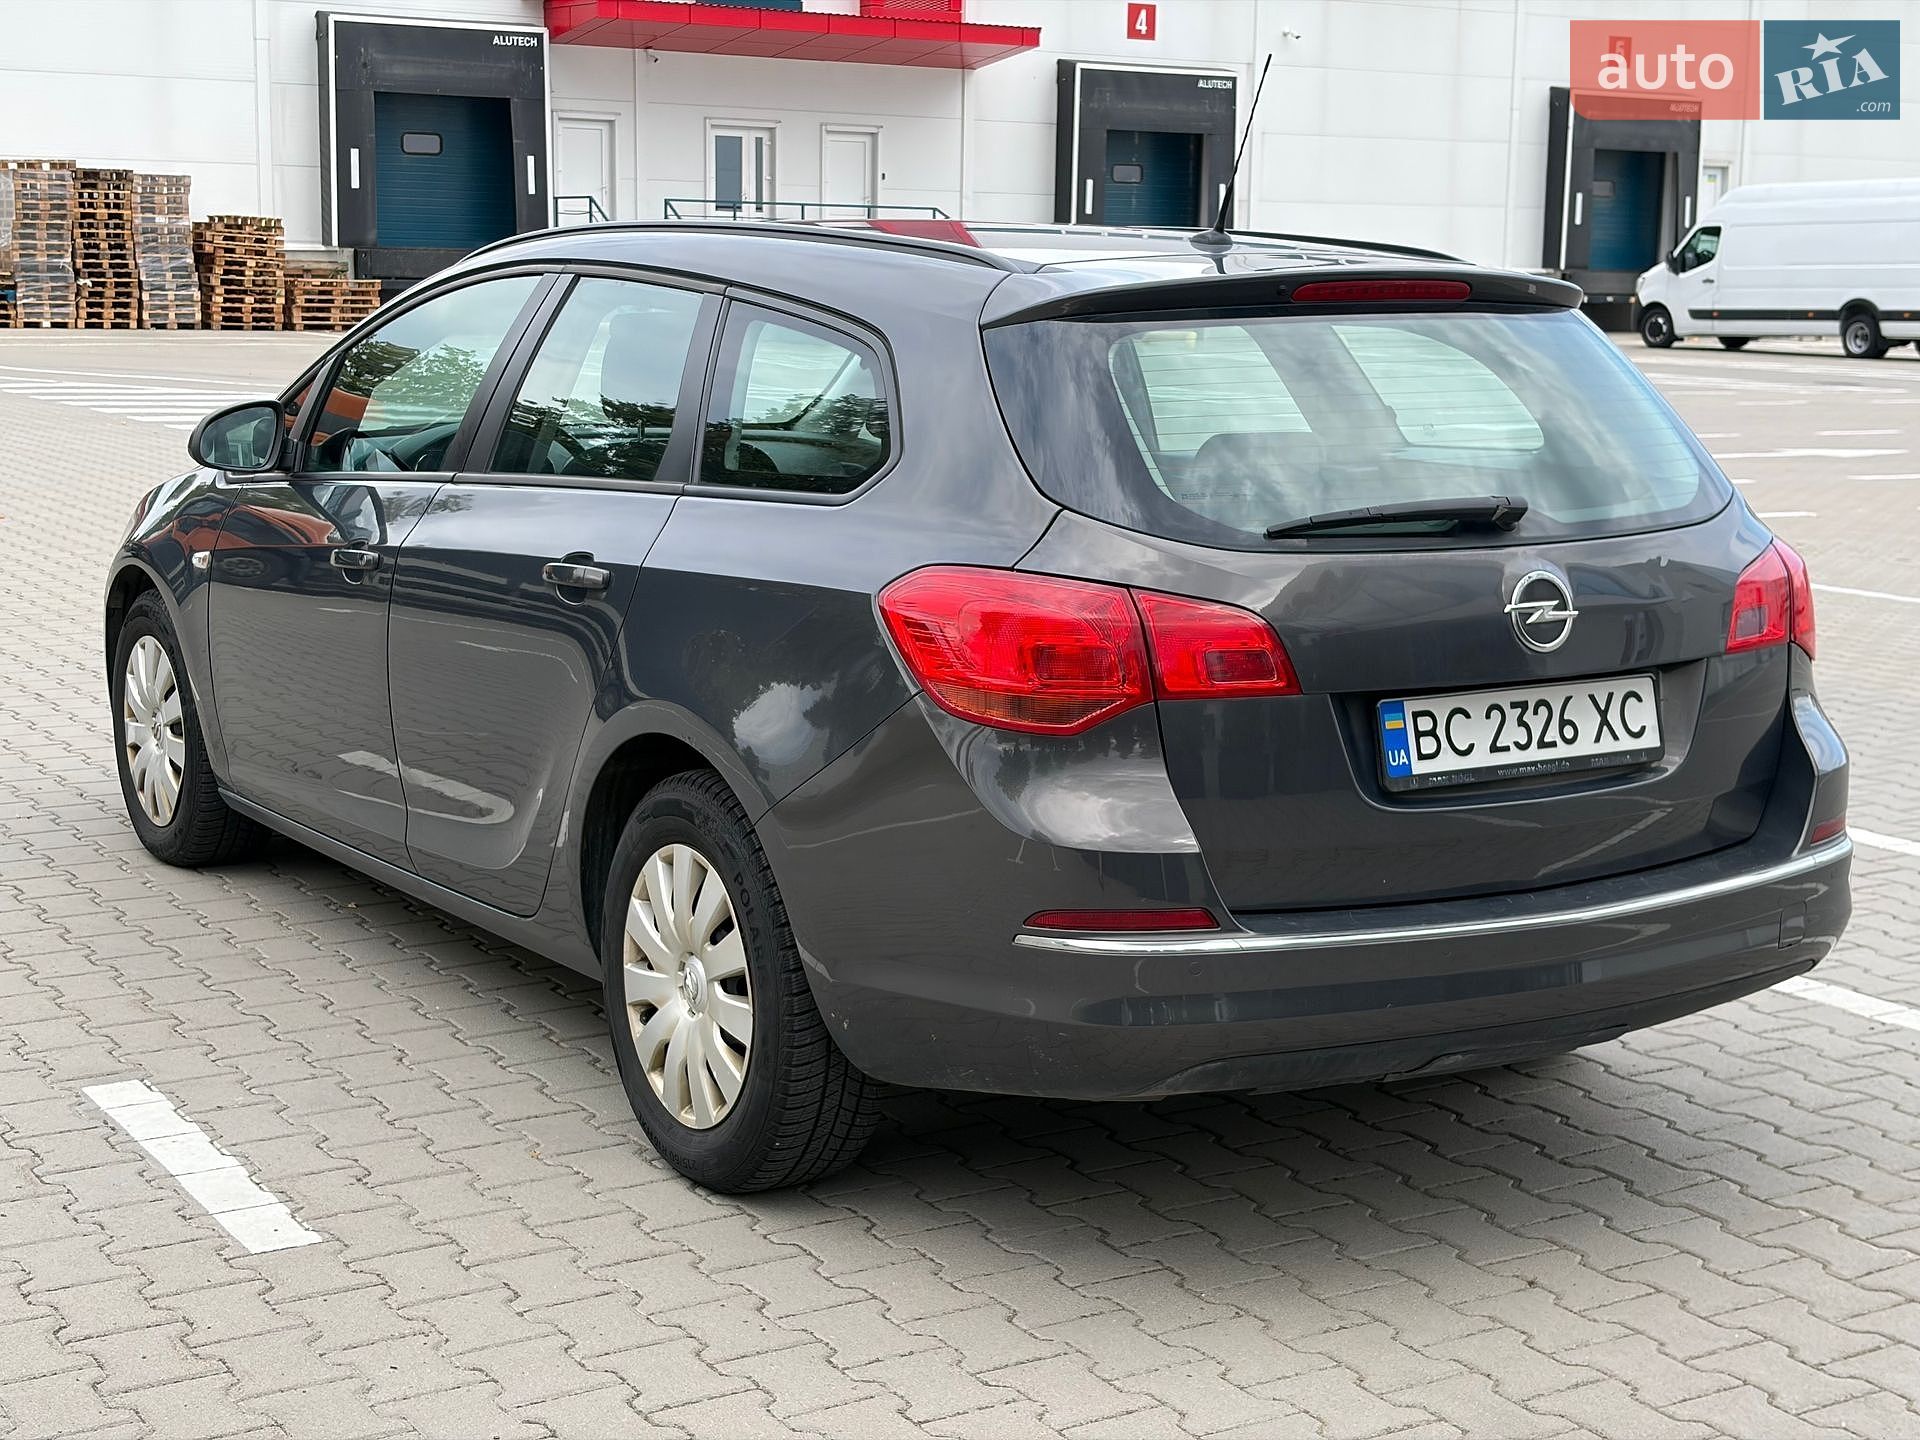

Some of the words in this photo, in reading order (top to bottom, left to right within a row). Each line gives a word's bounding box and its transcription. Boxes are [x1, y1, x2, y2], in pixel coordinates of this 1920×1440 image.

[1135, 8, 1147, 35] 4
[492, 34, 538, 47] ALUTECH
[1197, 79, 1233, 90] ALUTECH
[1410, 706, 1476, 762] BC
[1484, 695, 1580, 754] 2326
[1587, 689, 1647, 744] XC
[1388, 749, 1410, 766] UA
